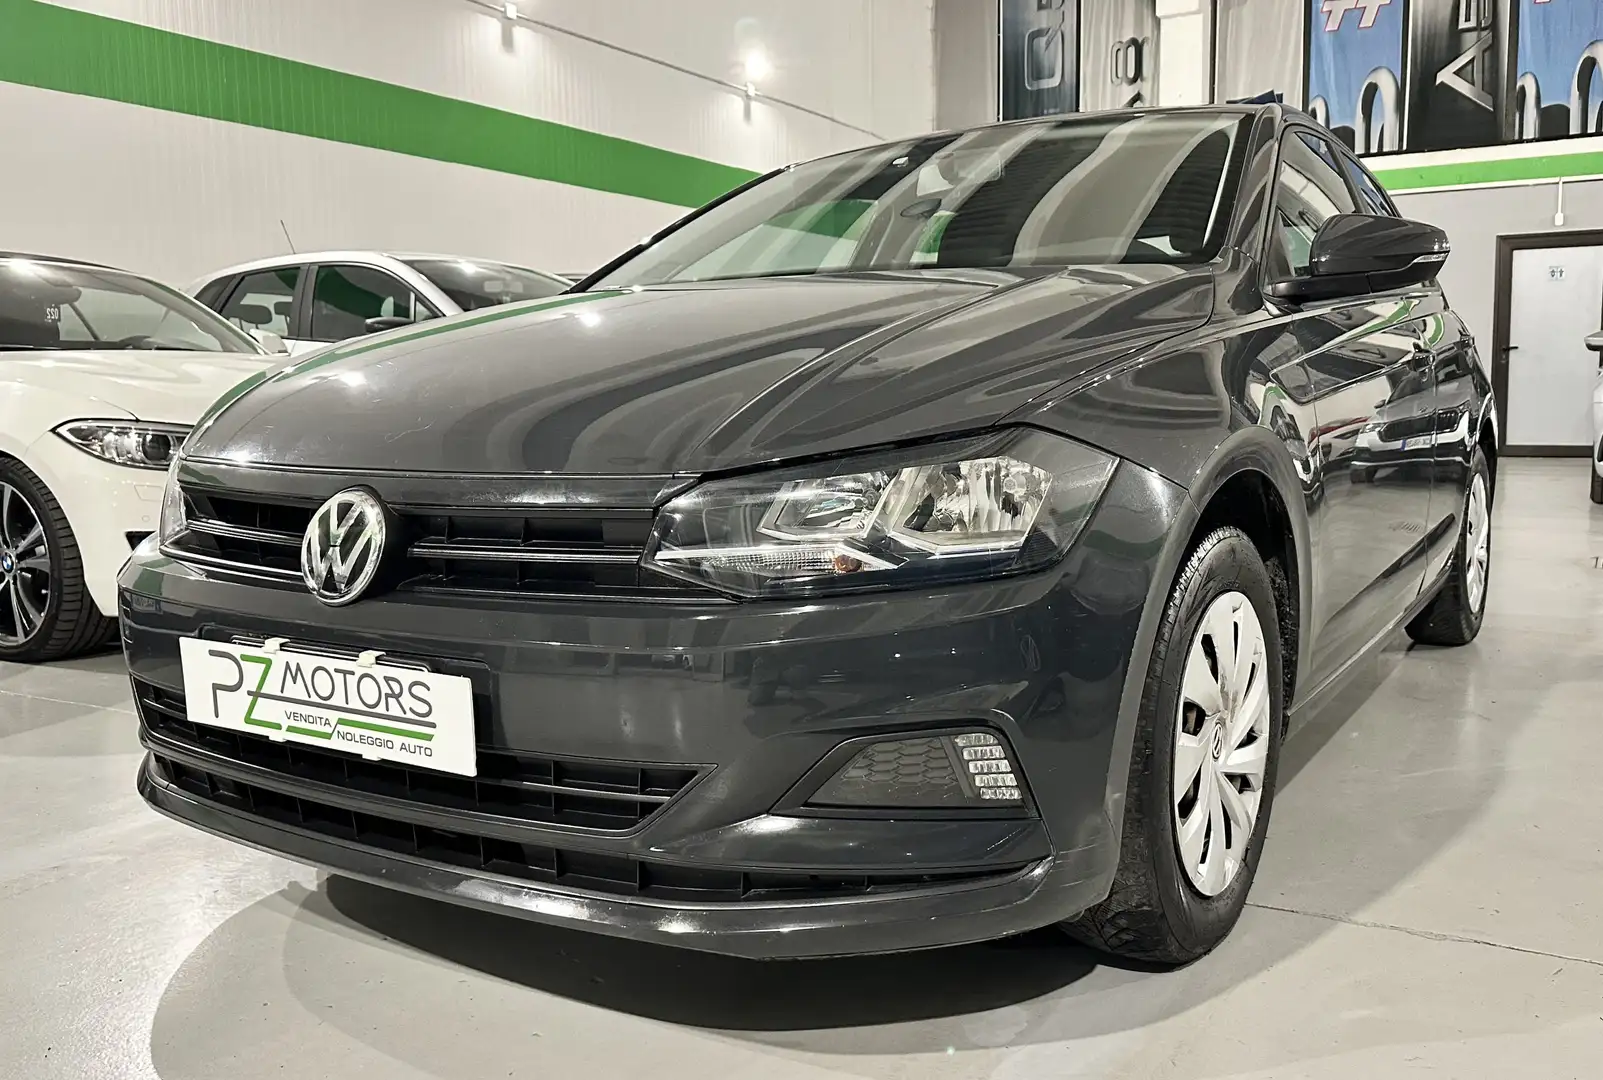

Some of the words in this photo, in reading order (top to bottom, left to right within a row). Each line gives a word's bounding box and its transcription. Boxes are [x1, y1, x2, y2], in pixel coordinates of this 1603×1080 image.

[208, 649, 283, 731] PZ
[280, 660, 433, 718] MOTORS
[284, 710, 333, 728] VENDITA
[337, 730, 395, 750] NOLEGGIO
[399, 742, 433, 758] AUTO
